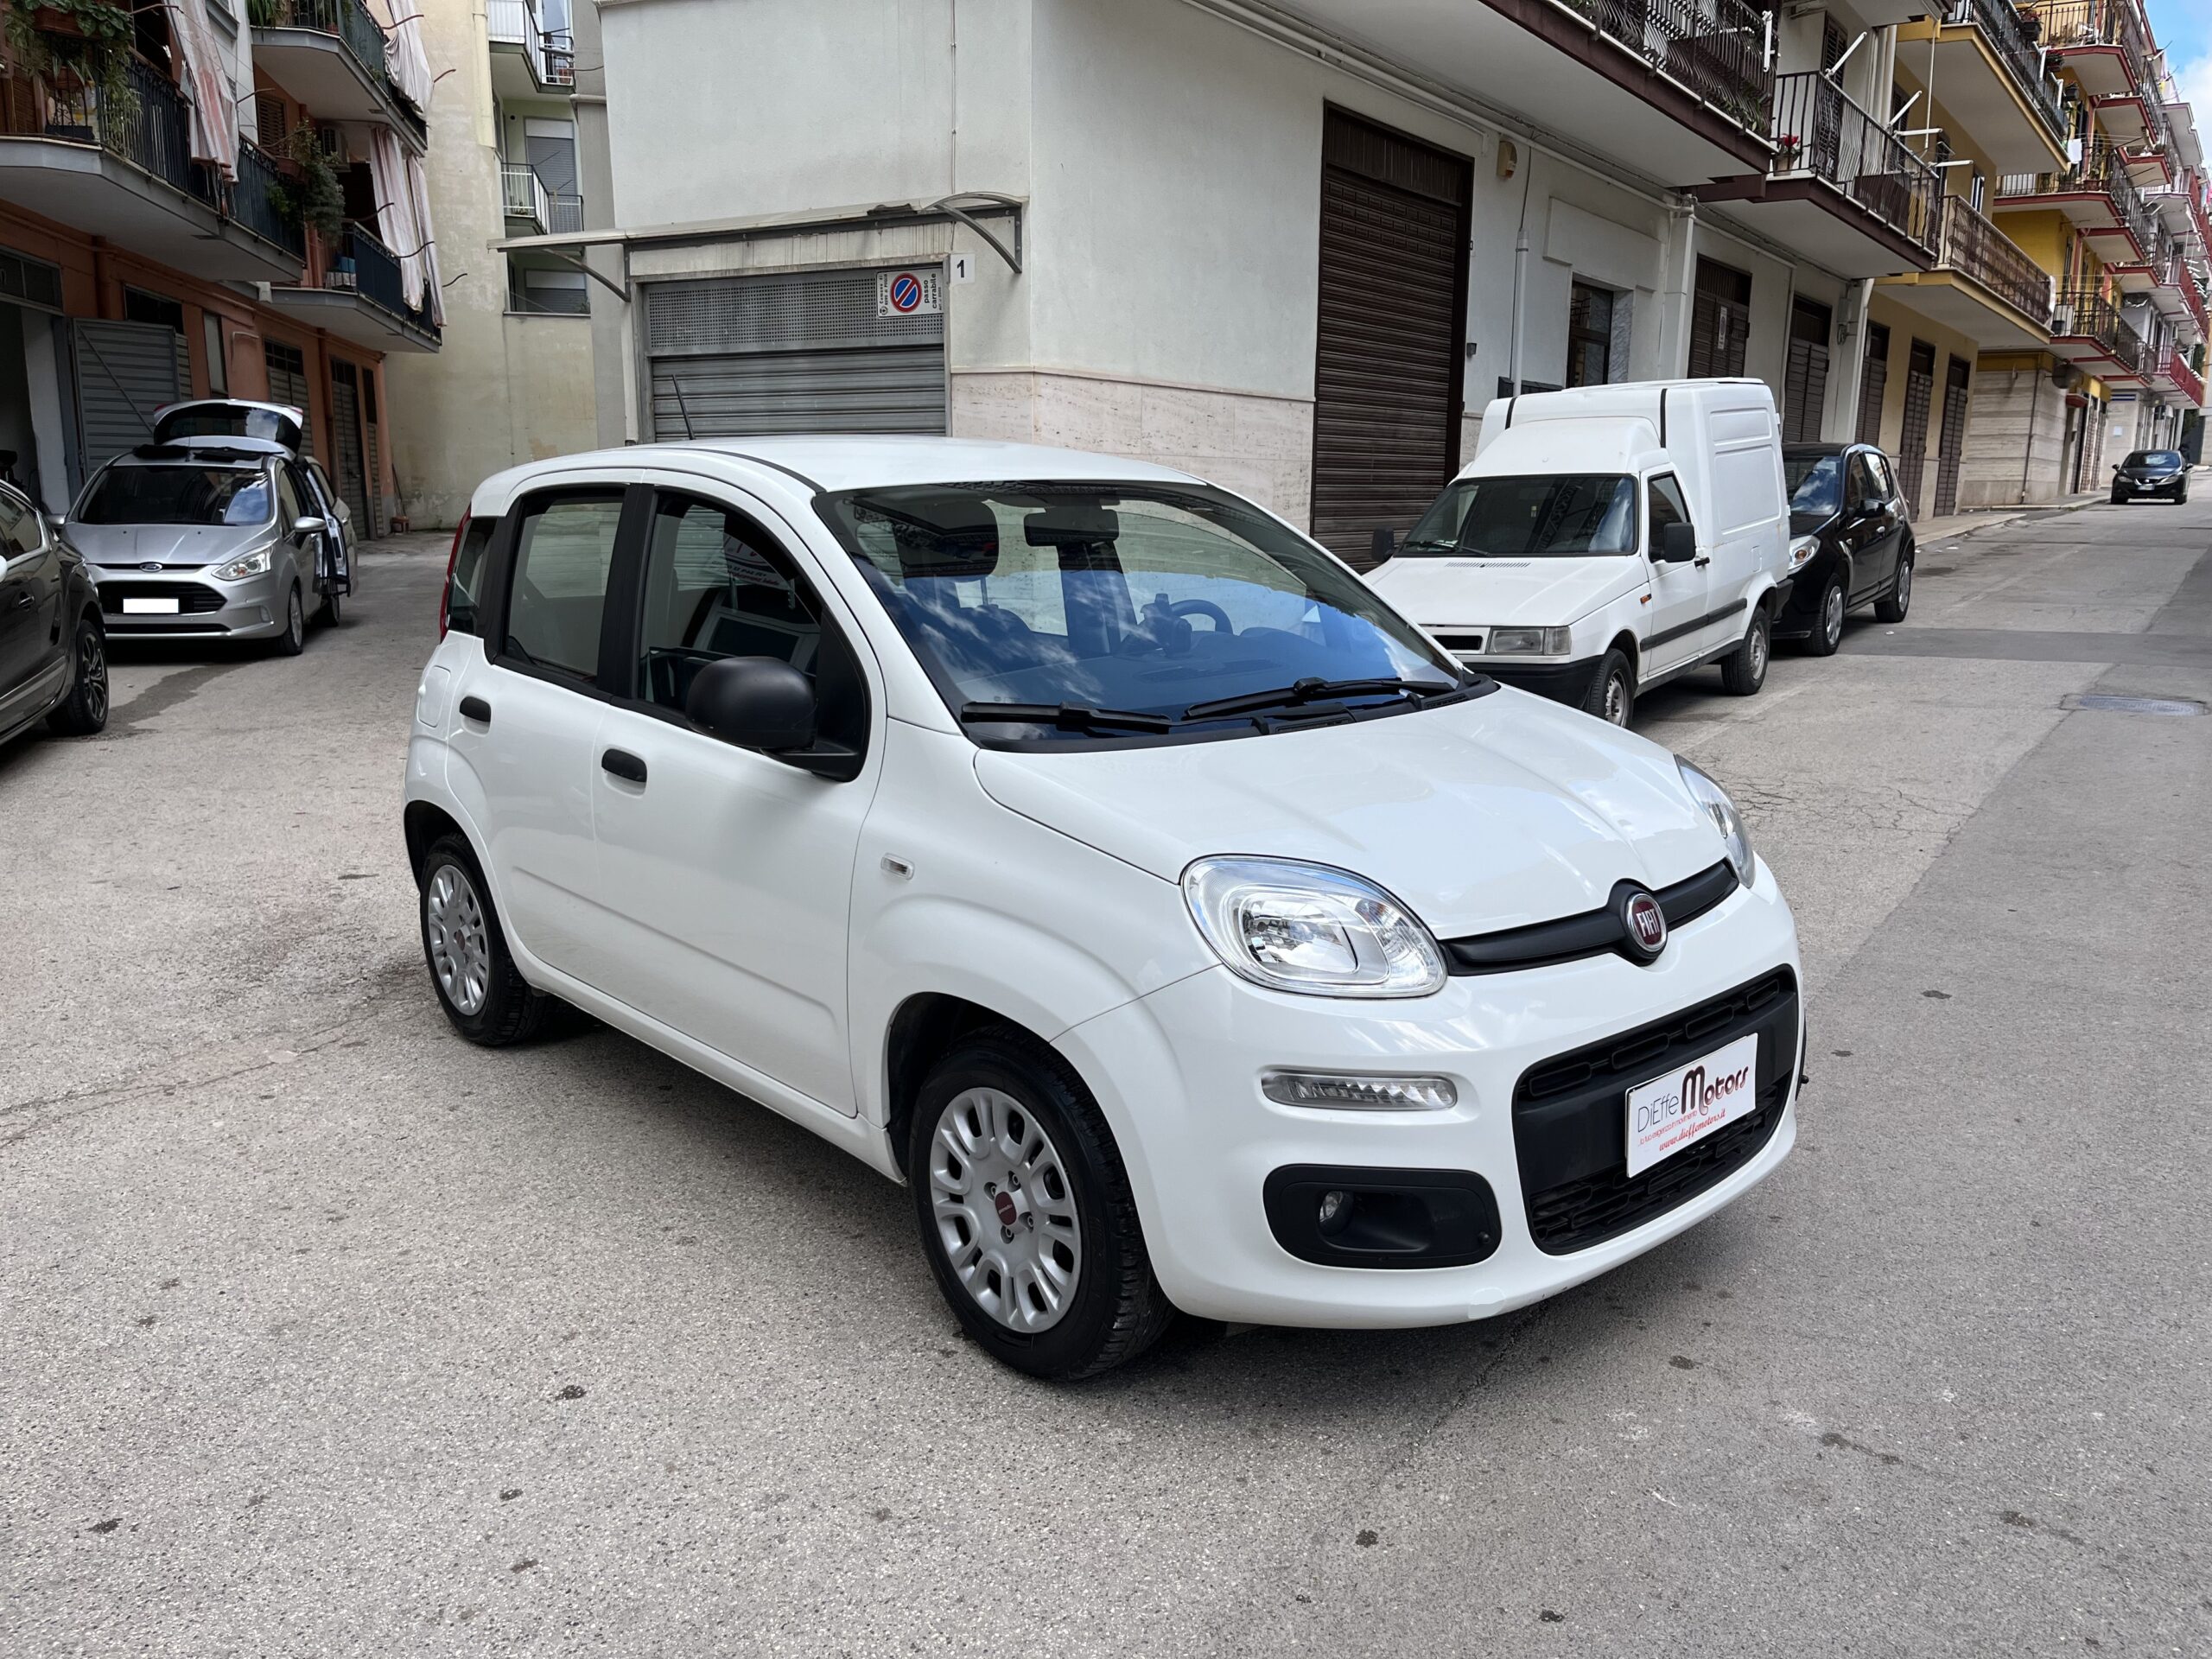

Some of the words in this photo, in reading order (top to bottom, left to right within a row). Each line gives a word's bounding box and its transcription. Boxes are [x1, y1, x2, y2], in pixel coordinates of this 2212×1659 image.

[957, 259, 964, 278] 1
[1636, 908, 1660, 938] FIAT
[1637, 1093, 1679, 1133] DiEffe
[1681, 1065, 1749, 1116] Motors
[1659, 1108, 1726, 1152] www.dieffemotors.it
